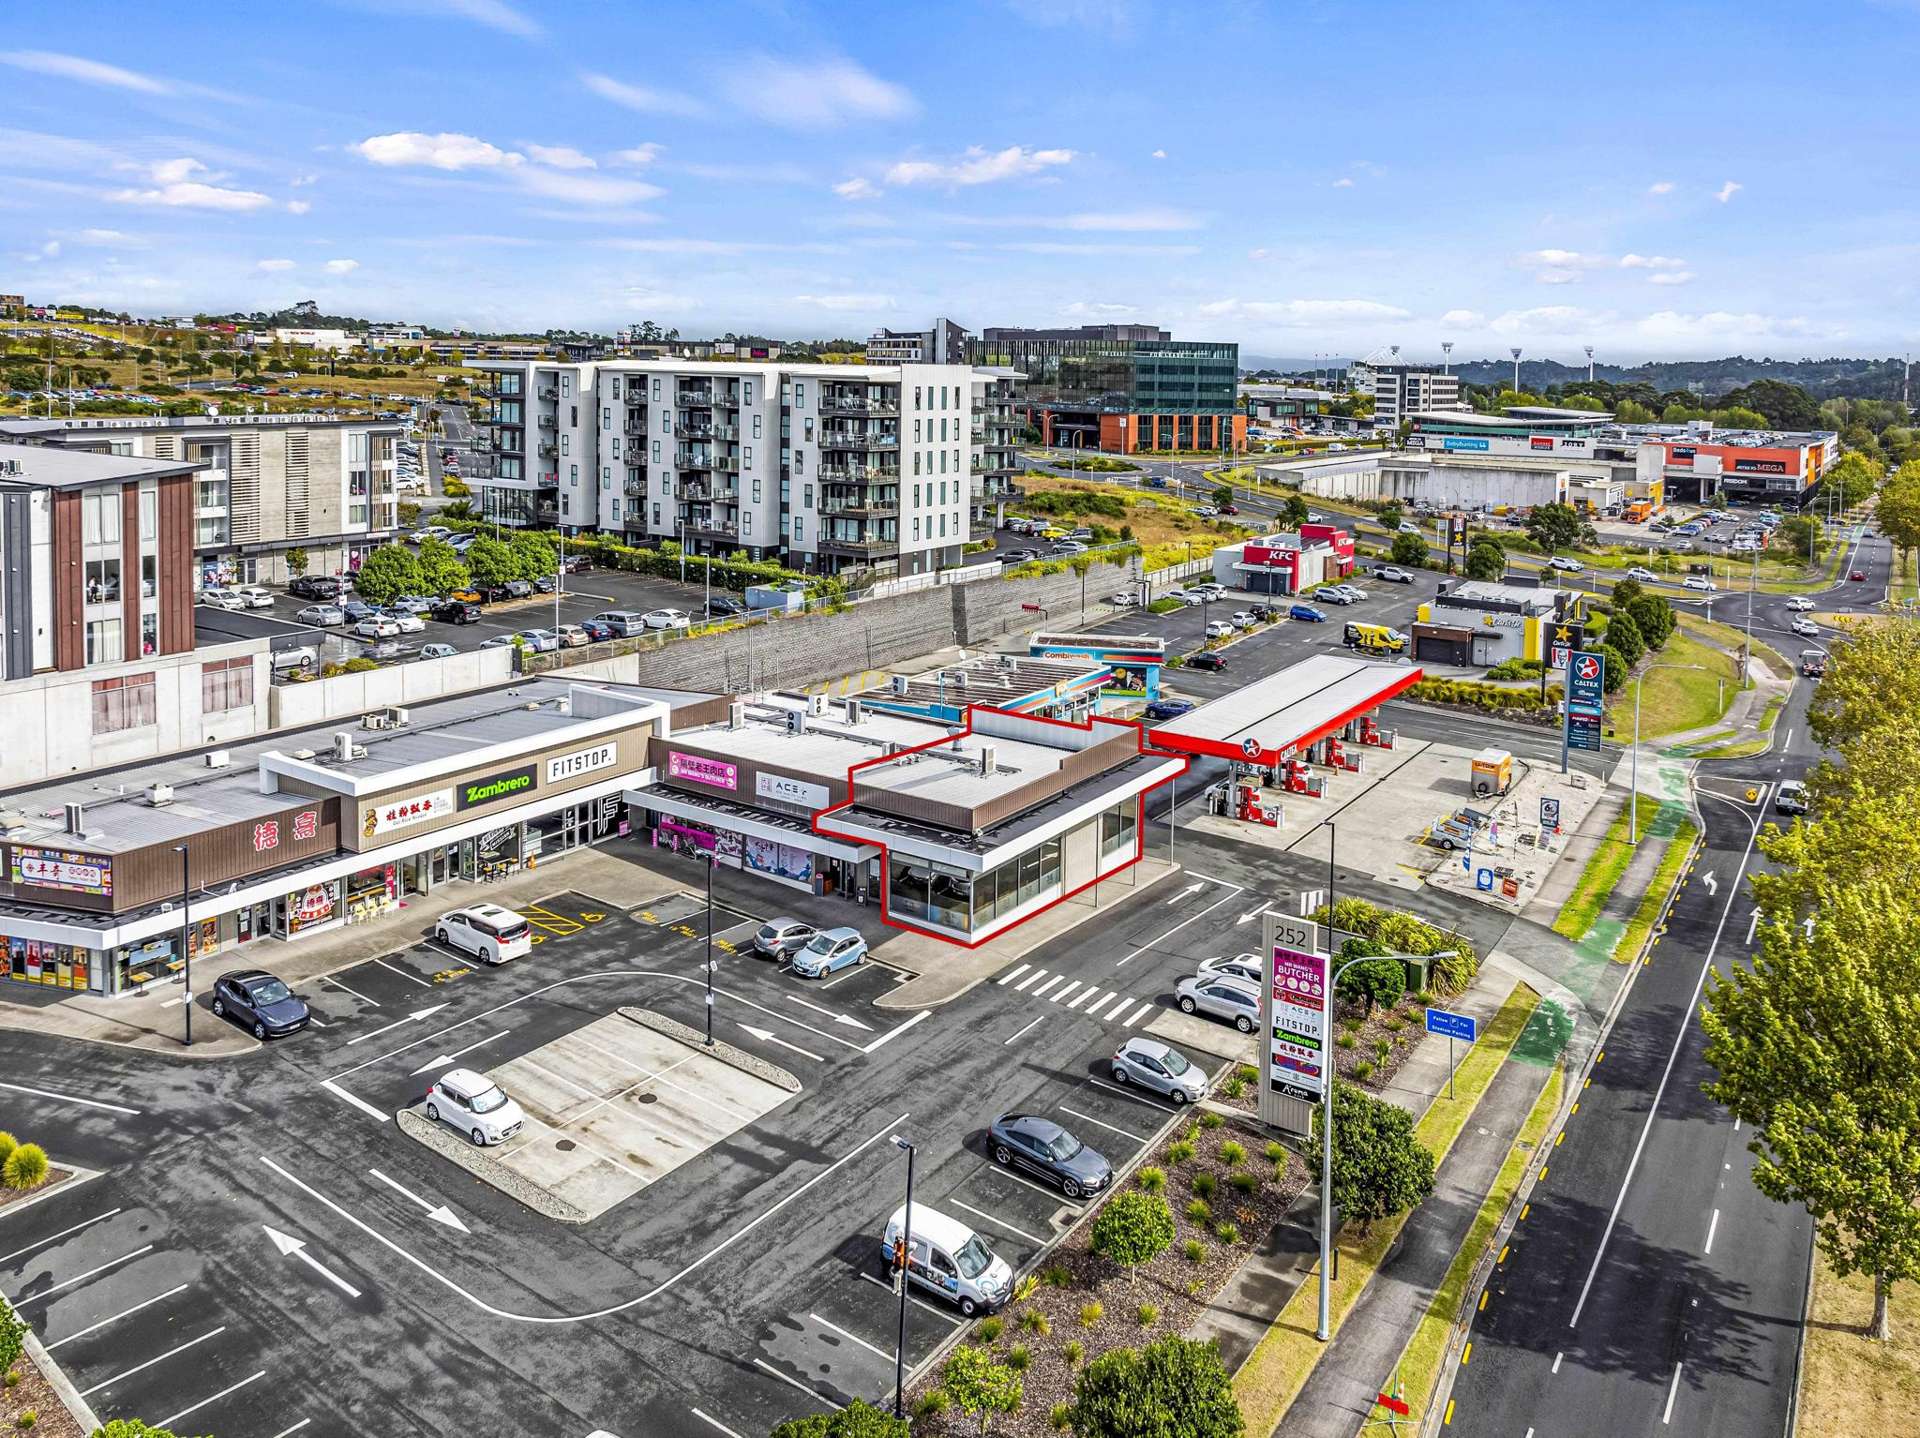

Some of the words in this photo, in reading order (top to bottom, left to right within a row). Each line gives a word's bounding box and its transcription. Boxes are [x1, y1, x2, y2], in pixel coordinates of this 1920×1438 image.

[1756, 464, 1784, 473] MEGA
[1269, 551, 1294, 560] KFC
[1574, 680, 1599, 688] CALTEX
[466, 775, 530, 802] Zambrero
[1275, 926, 1306, 947] 252
[1278, 965, 1320, 983] BUTCHER
[1276, 1029, 1319, 1049] Zambrero
